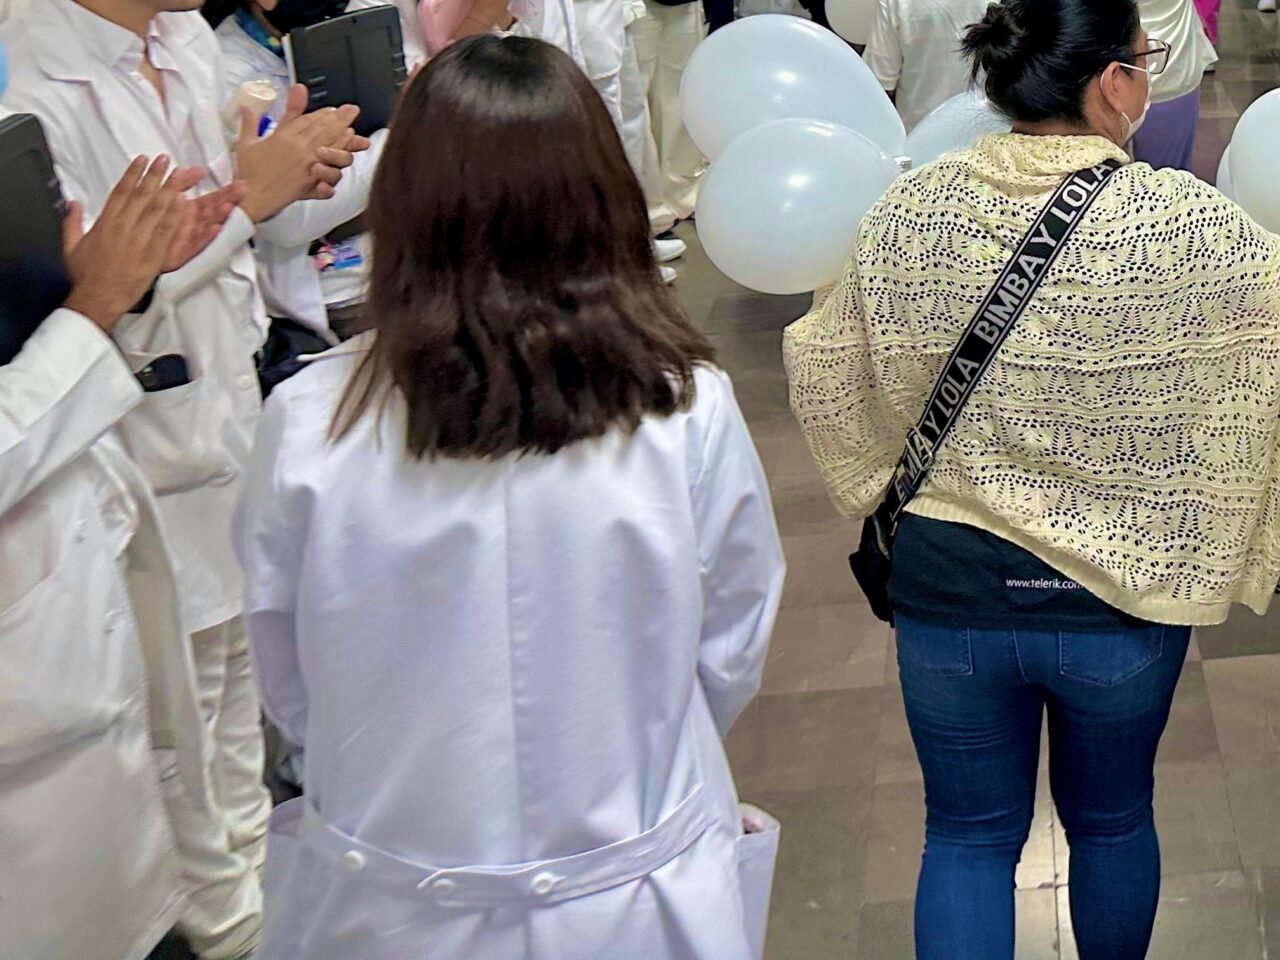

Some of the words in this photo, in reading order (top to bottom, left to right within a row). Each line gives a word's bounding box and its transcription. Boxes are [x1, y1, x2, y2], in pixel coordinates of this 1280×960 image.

[1030, 222, 1058, 248] Y
[1050, 163, 1114, 225] LOLA
[924, 410, 941, 436] Y
[935, 355, 980, 421] LOLA
